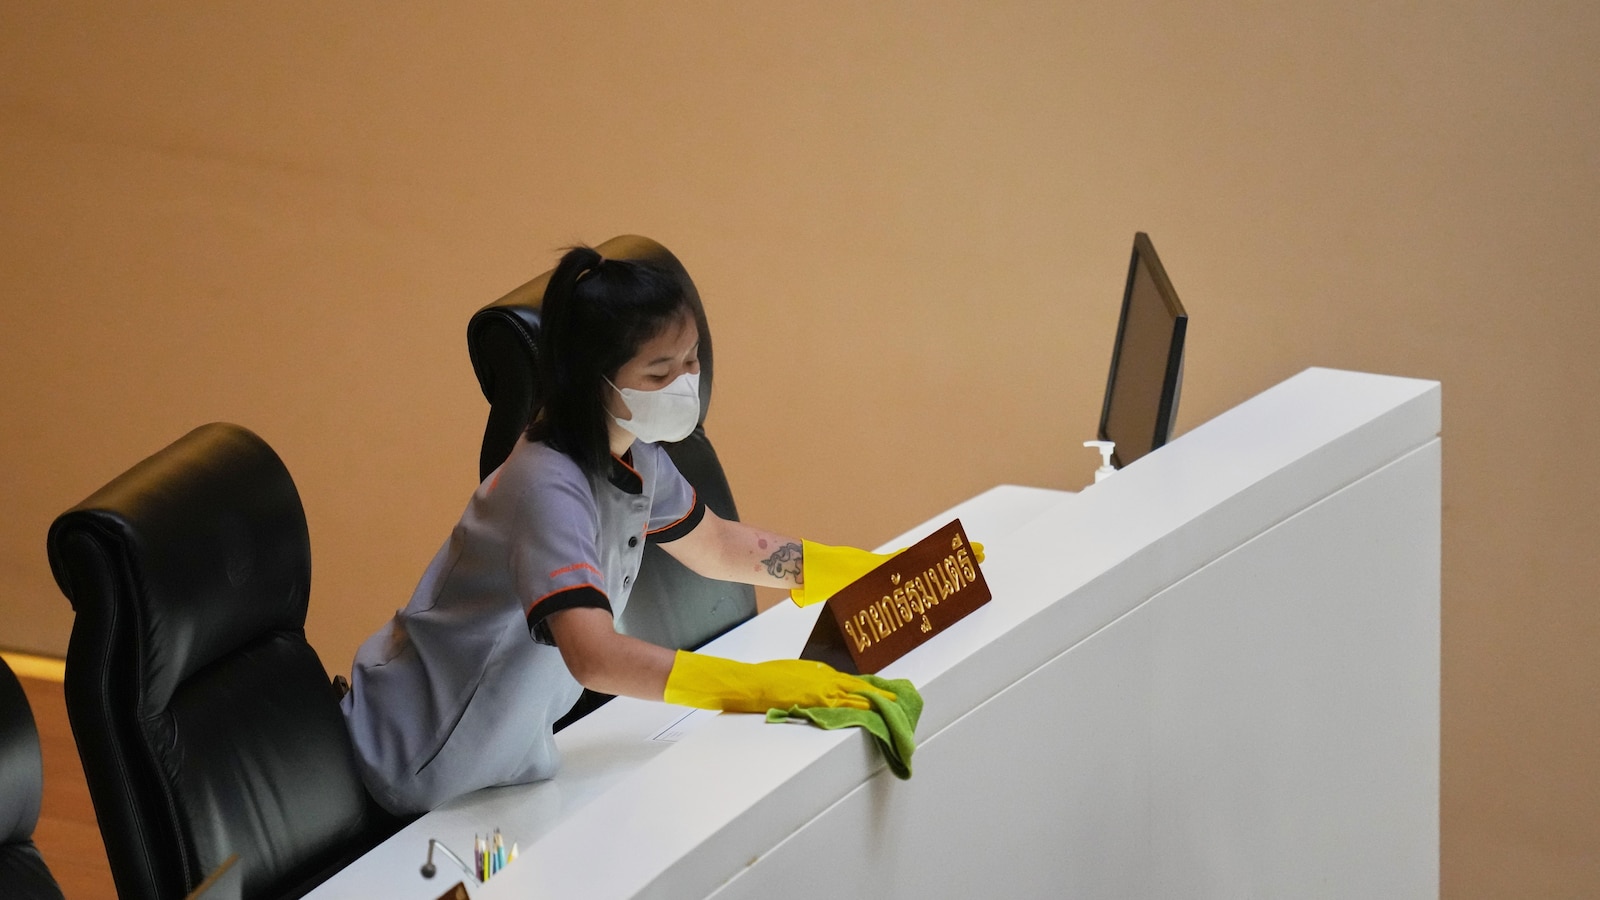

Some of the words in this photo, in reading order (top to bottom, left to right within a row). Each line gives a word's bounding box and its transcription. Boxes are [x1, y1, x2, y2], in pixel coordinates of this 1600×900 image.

[844, 532, 976, 653] นายกรัฐมนตรี
